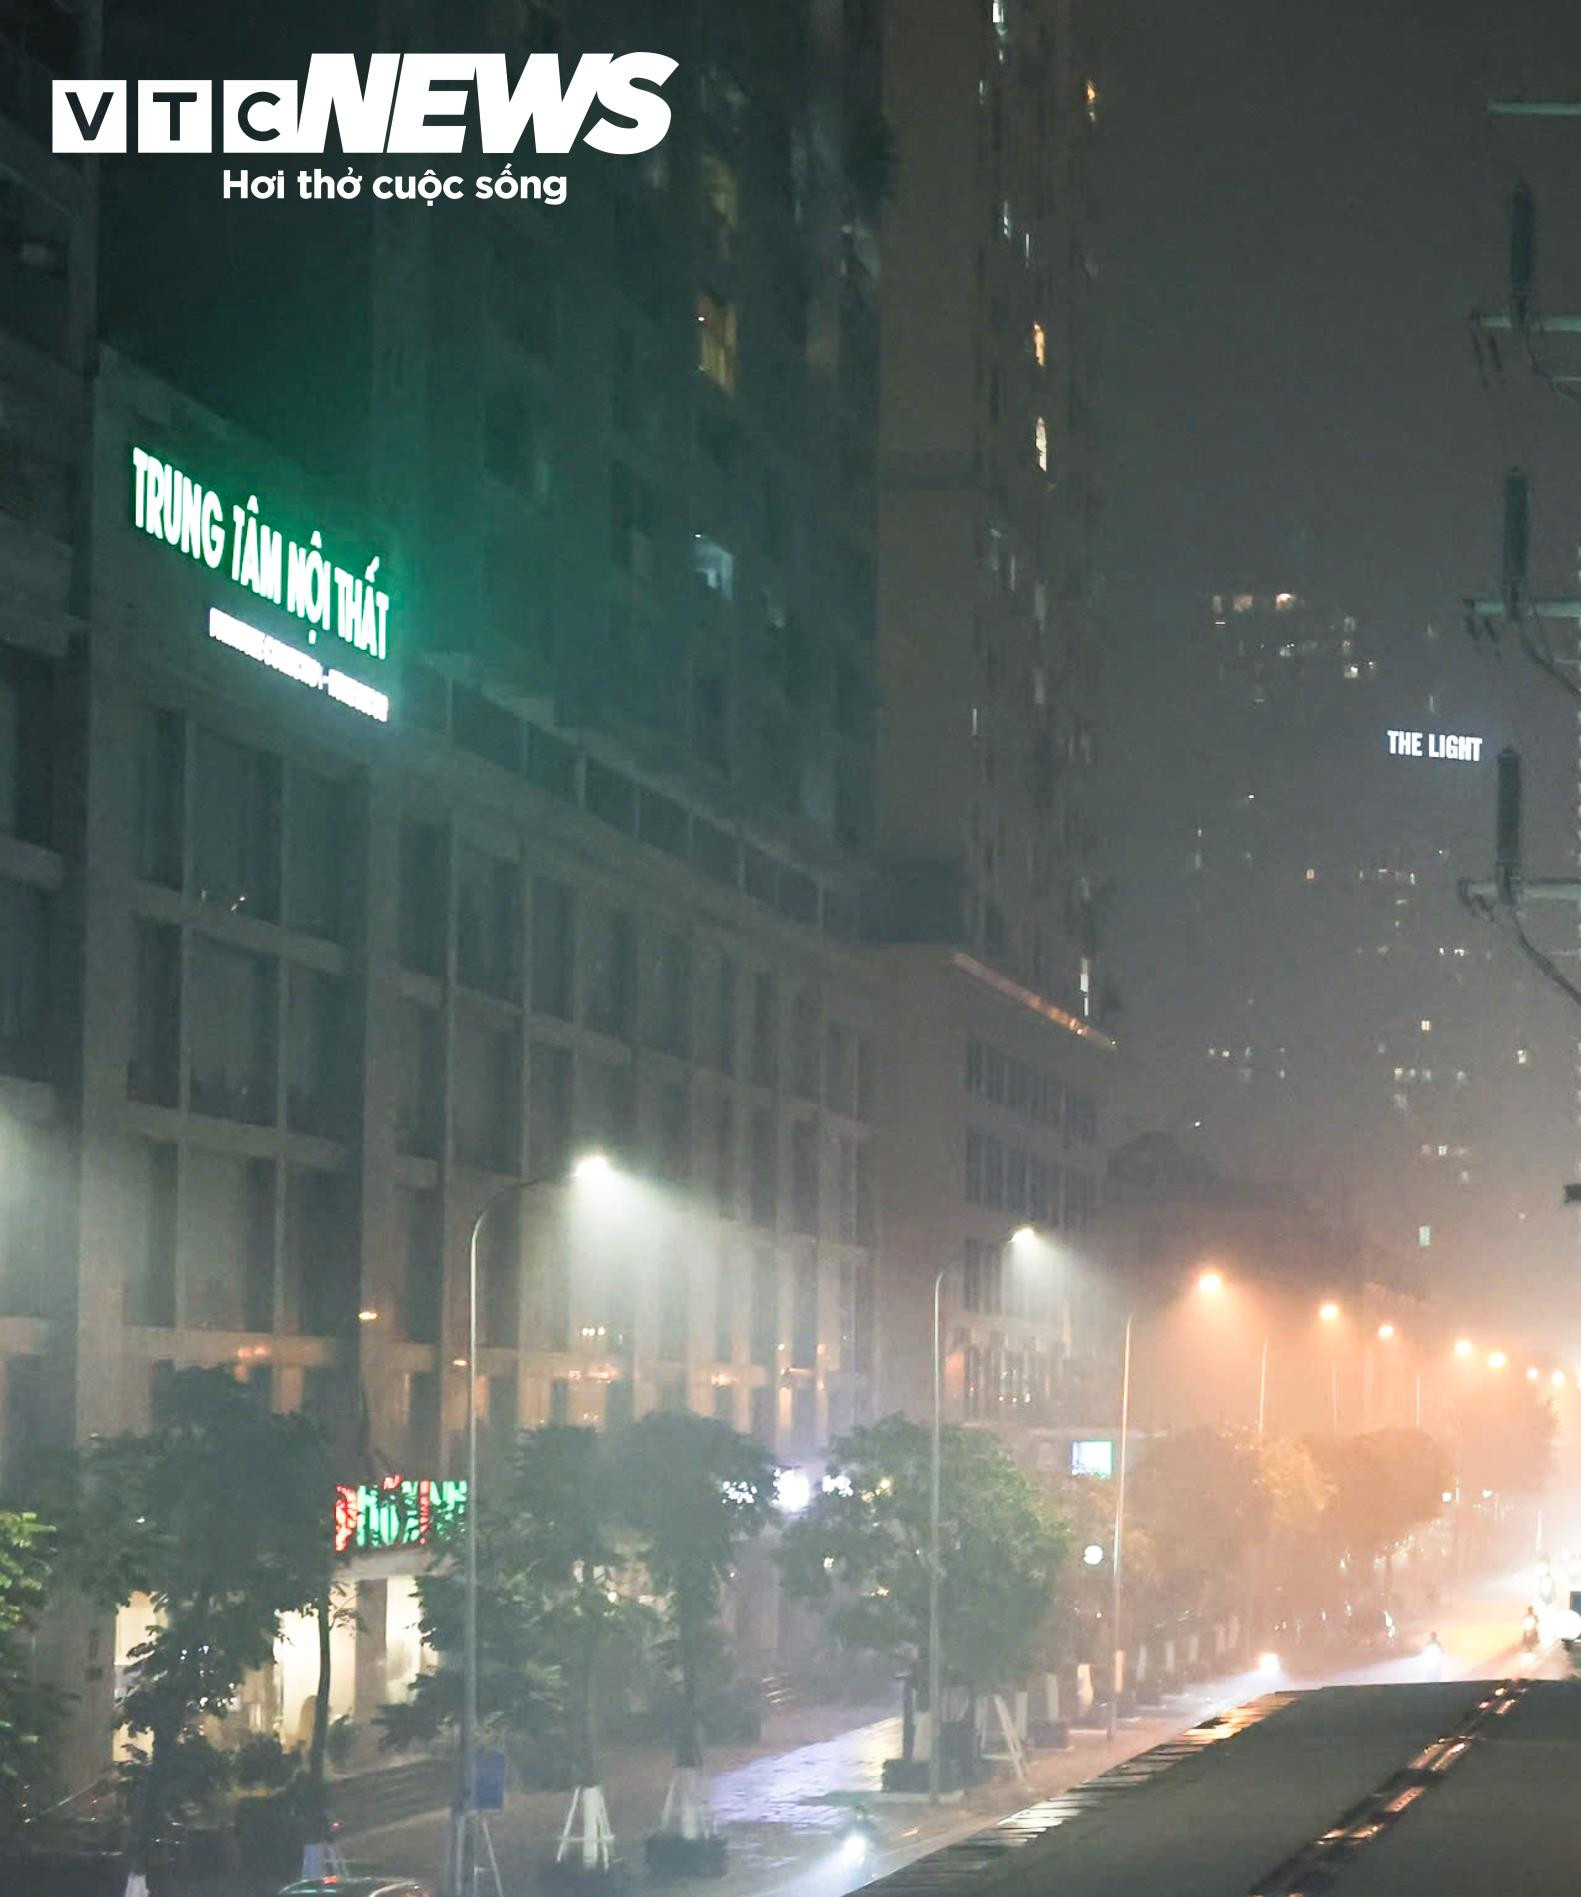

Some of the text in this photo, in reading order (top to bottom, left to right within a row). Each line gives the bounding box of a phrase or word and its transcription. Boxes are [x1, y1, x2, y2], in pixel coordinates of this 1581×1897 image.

[133, 446, 389, 660] TRUNG TÂM NỘI THẤT
[1386, 730, 1483, 762] THE LIGHT
